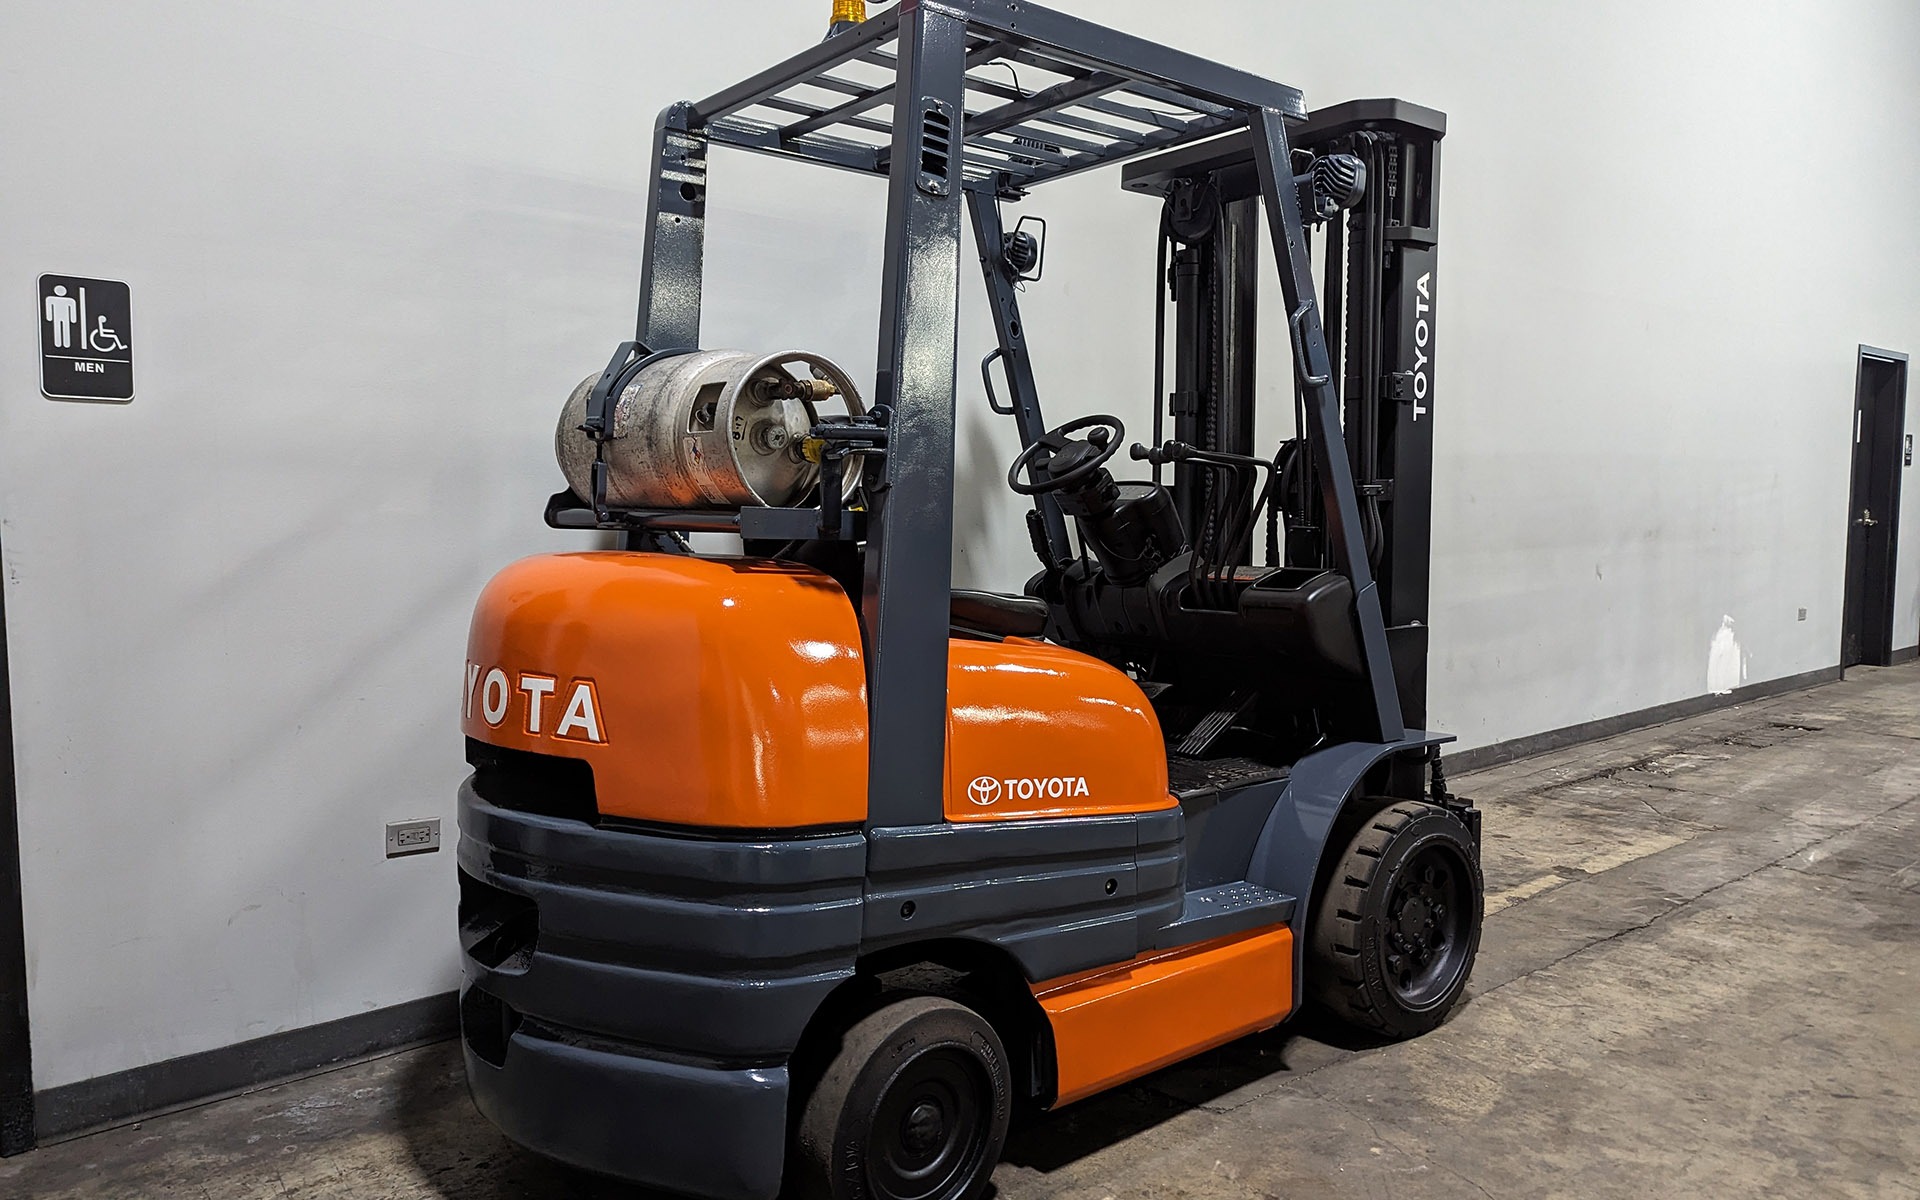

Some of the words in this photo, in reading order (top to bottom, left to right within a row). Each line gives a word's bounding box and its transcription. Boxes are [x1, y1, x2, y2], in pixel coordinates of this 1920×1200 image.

[75, 361, 104, 373] MEN
[1413, 272, 1431, 421] TOYOTA
[466, 663, 600, 742] YOTA
[1004, 777, 1089, 800] TOYOTA
